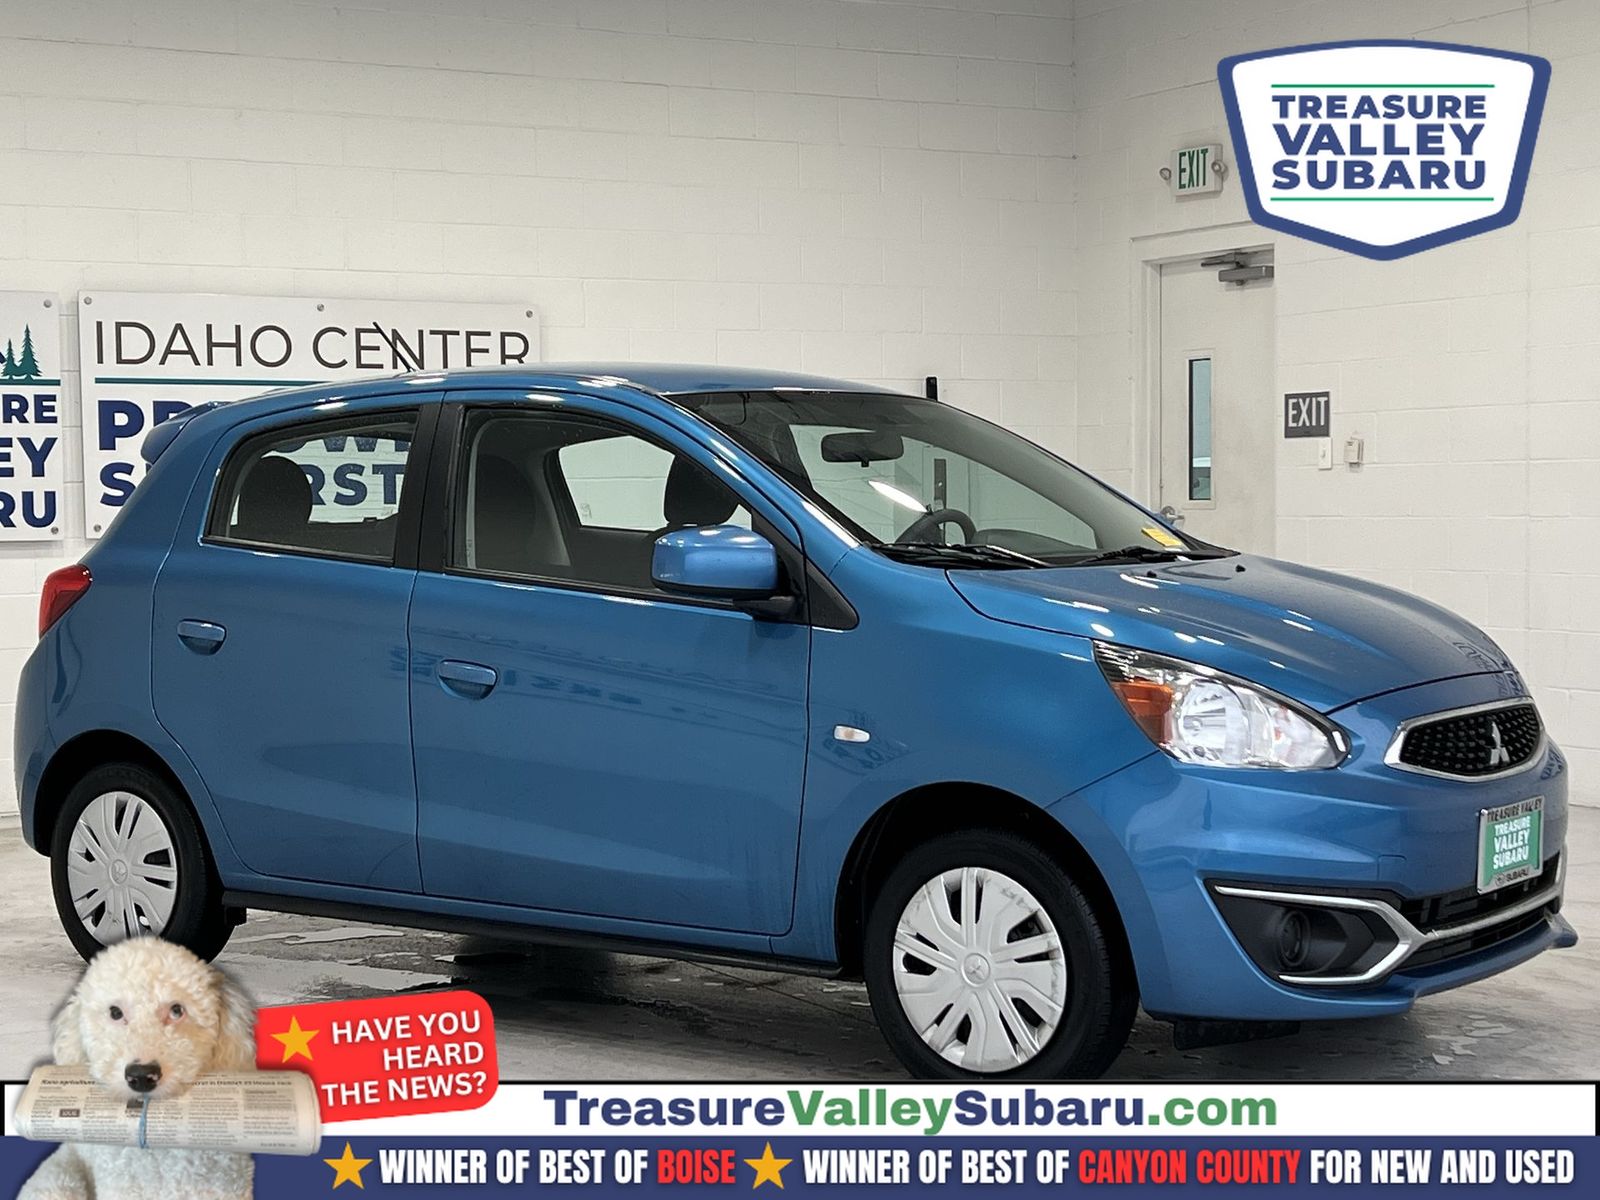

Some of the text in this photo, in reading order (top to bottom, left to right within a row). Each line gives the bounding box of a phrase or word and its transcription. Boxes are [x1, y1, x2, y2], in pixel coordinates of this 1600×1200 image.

[1178, 148, 1209, 190] EXIT
[95, 320, 531, 370] IDAHO CENTER
[1287, 396, 1329, 428] EXIT
[1494, 815, 1531, 836] TREASURE
[1493, 829, 1530, 853] VALLEY
[1493, 845, 1529, 870] SUBARU
